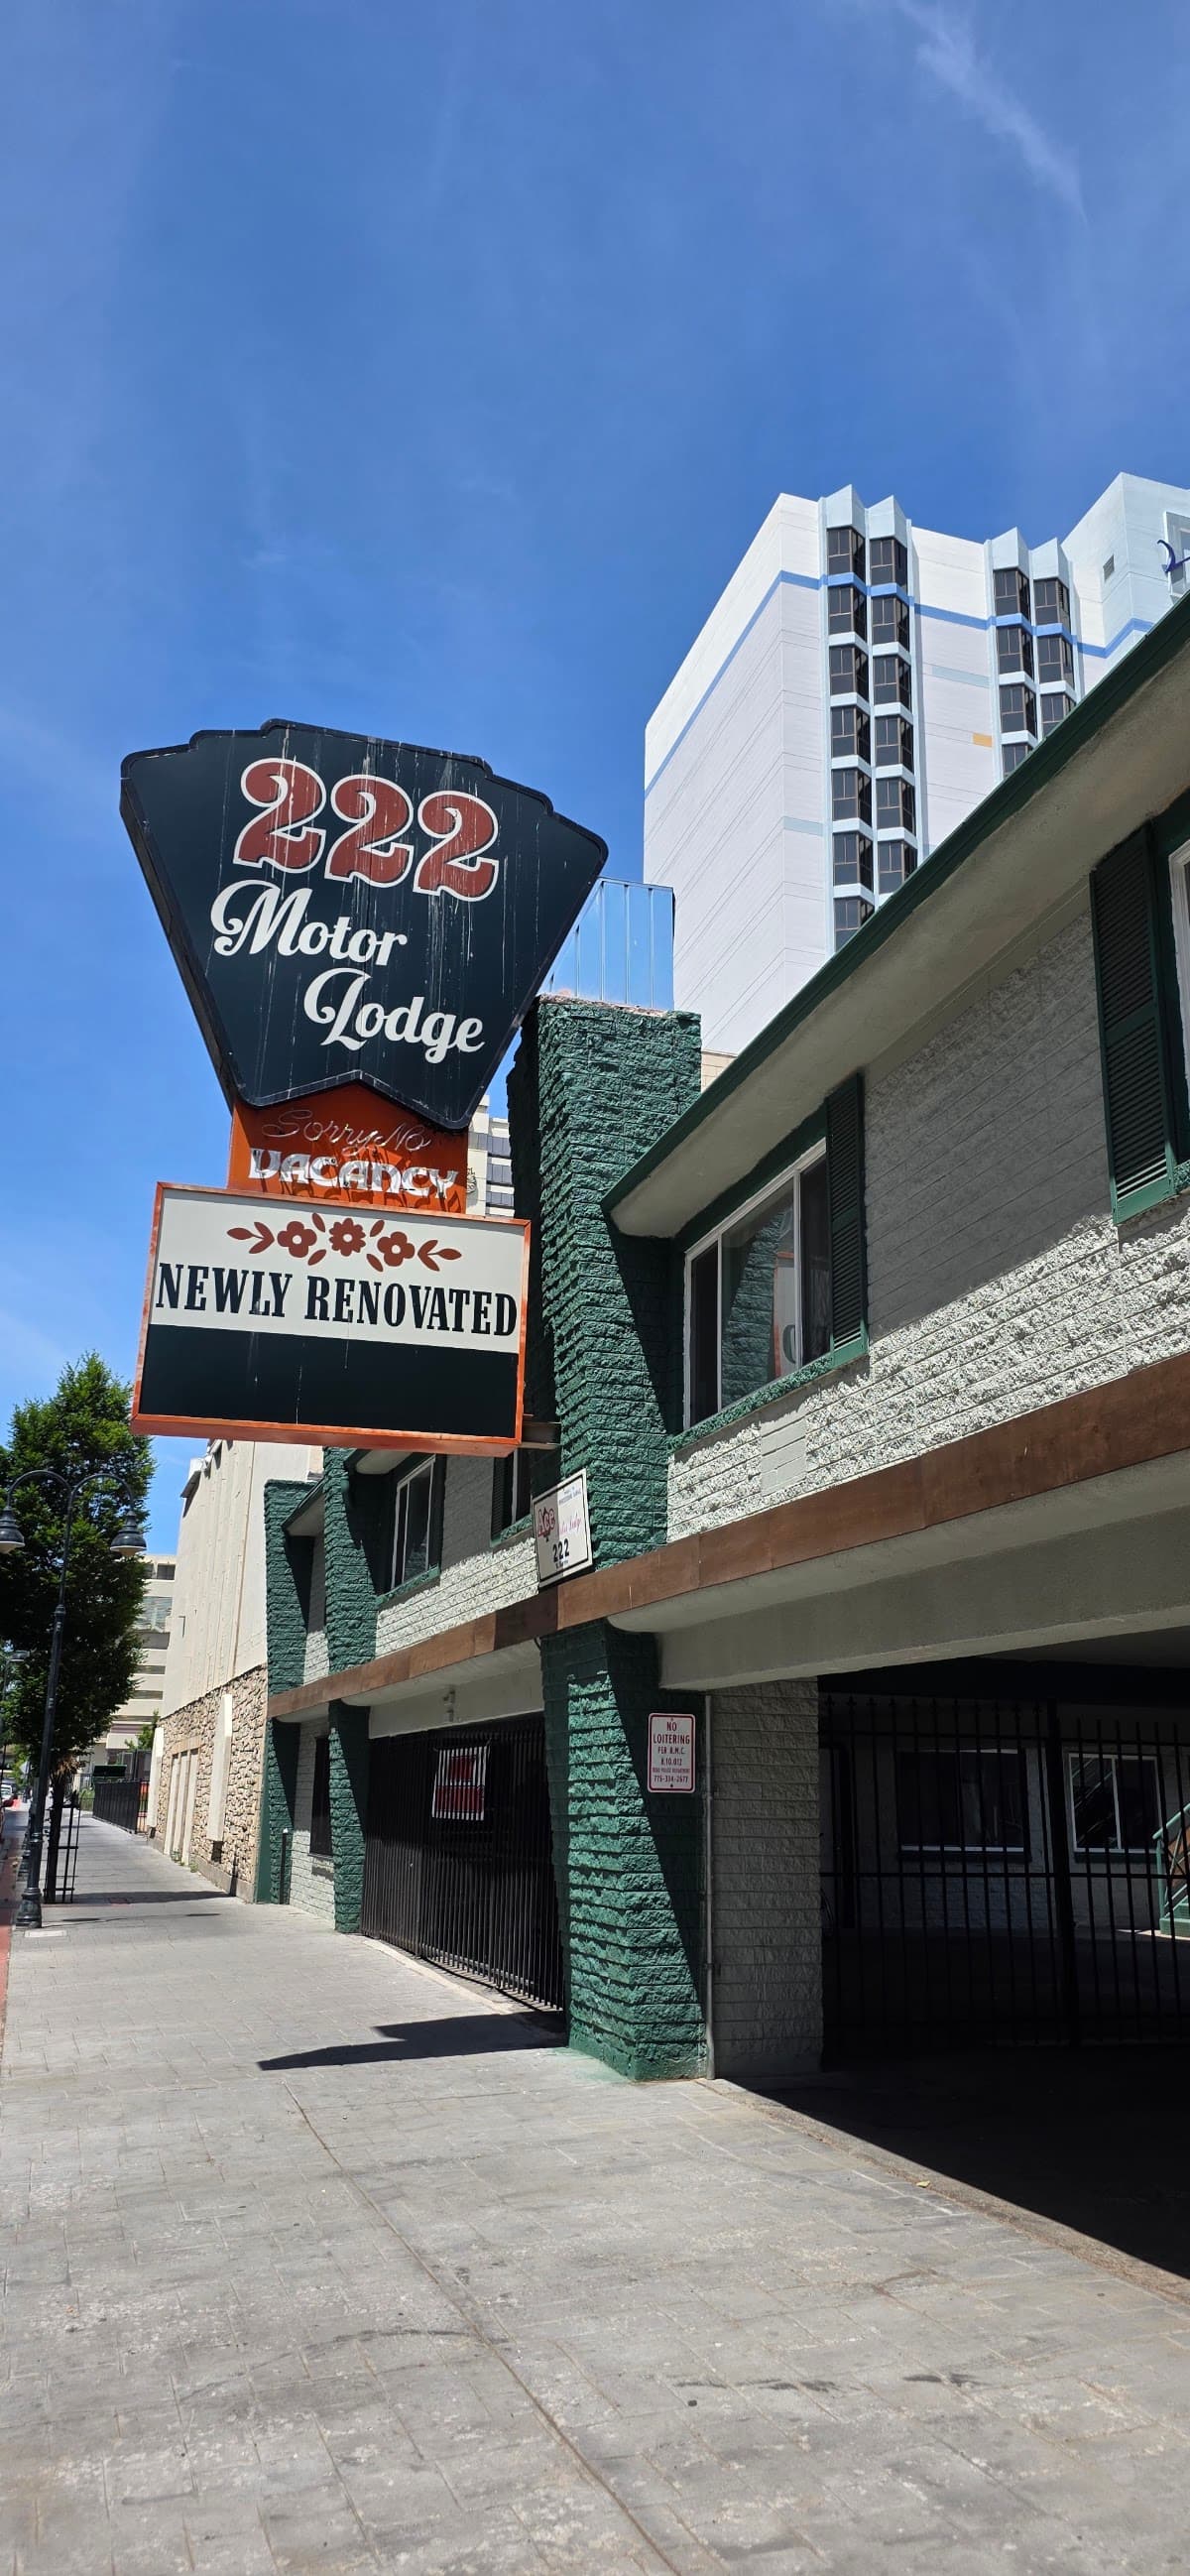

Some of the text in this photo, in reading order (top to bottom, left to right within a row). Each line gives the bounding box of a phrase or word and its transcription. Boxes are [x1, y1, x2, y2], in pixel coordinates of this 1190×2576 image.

[233, 757, 499, 902] 222
[210, 880, 407, 966] Motor
[303, 967, 486, 1064] Lodge
[261, 1109, 379, 1157] Sorry
[248, 1148, 458, 1199] VACANCY
[155, 1262, 518, 1337] NEWLY RENOVATED
[552, 1537, 569, 1562] 222
[653, 1734, 690, 1745] LOITERING
[666, 1721, 677, 1731] NO
